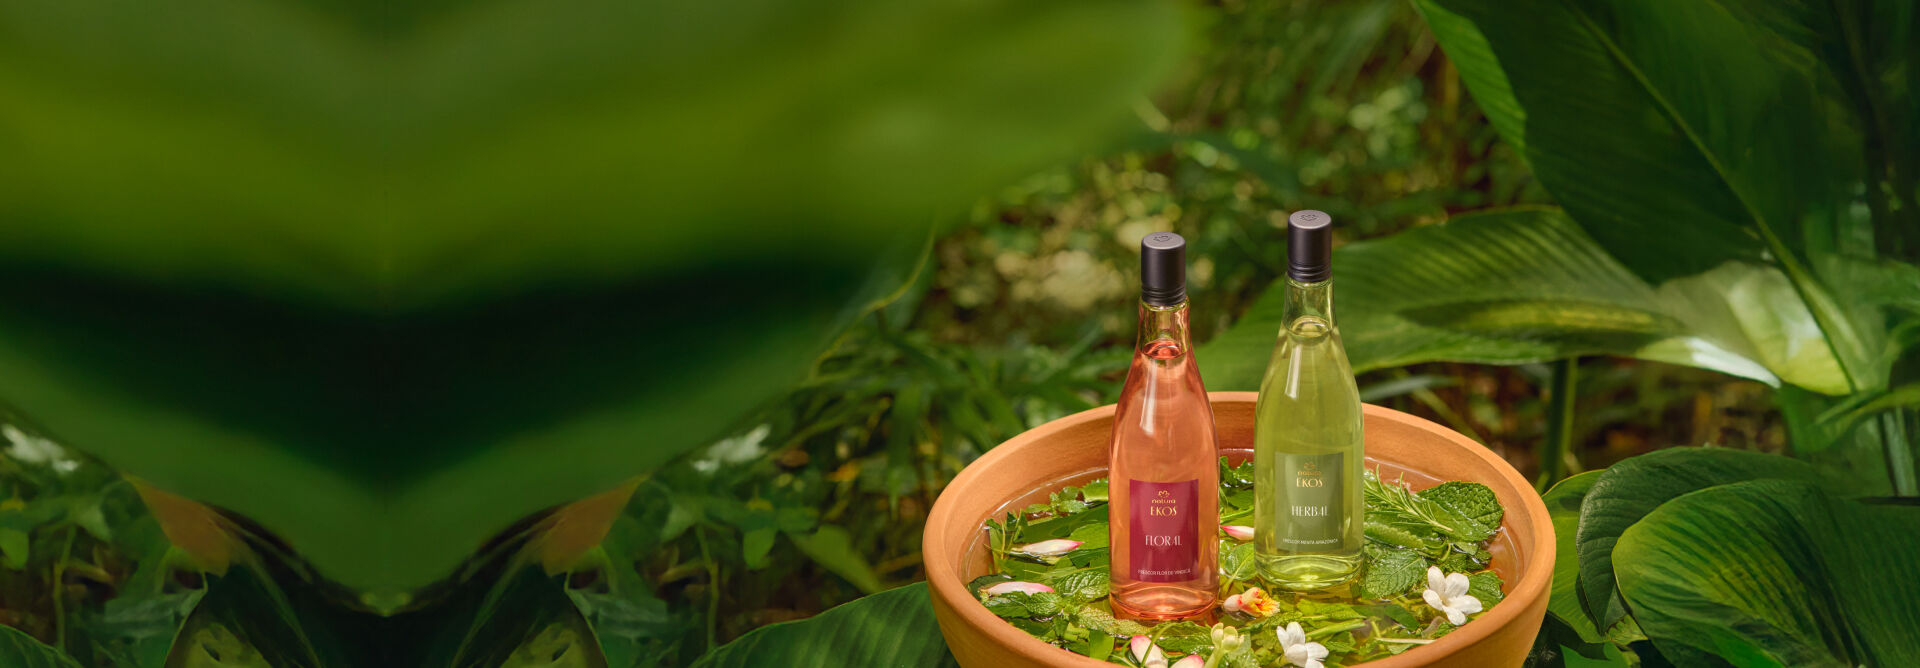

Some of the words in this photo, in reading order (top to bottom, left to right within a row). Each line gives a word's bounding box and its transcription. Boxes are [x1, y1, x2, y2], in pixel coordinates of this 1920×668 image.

[1296, 477, 1323, 488] EKOS
[1150, 506, 1177, 516] EKOS
[1291, 505, 1328, 517] HERBAL
[1145, 535, 1182, 546] FLORAL
